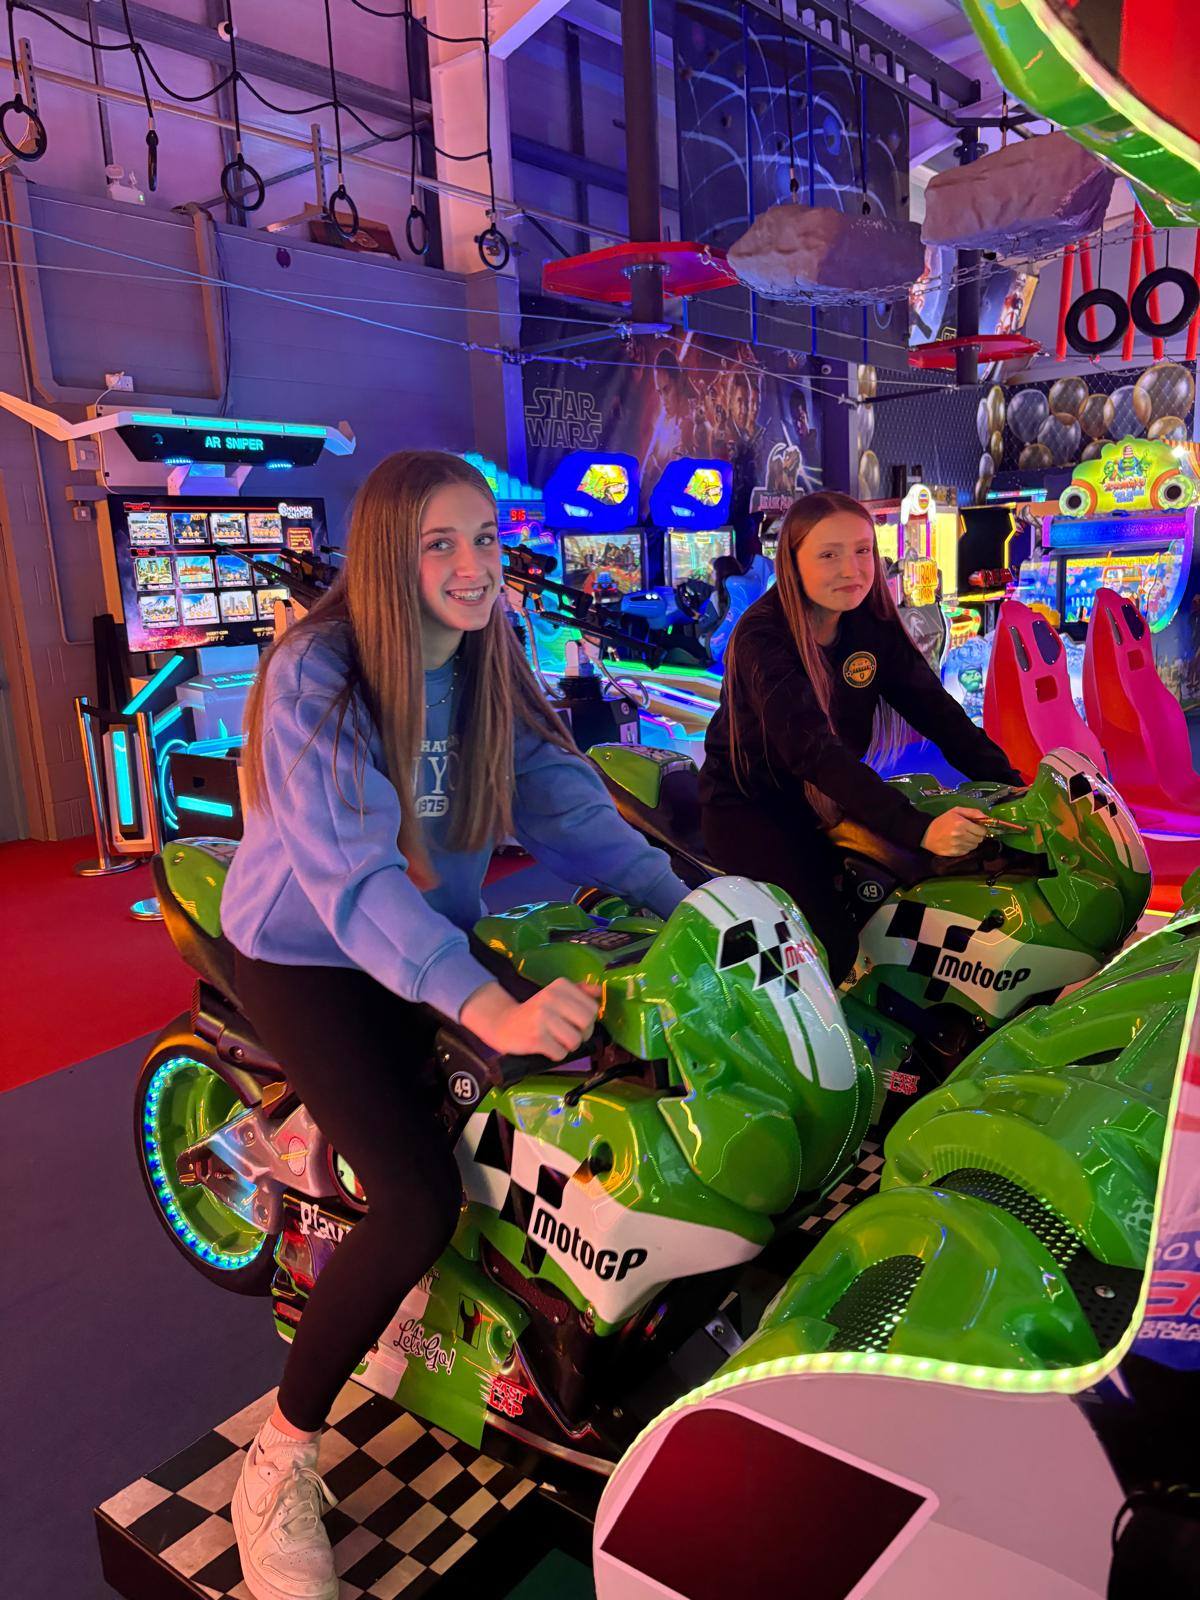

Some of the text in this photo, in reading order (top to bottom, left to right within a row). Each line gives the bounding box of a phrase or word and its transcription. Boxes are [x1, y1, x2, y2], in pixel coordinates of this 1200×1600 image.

[524, 387, 602, 422] STAR
[205, 435, 264, 451] AR SNIPER
[525, 417, 602, 450] WARS
[863, 885, 878, 898] 49
[937, 954, 1031, 992] motoGP
[454, 1078, 472, 1099] 49
[889, 1081, 918, 1096] LAP
[890, 1070, 920, 1084] FAST
[532, 1207, 648, 1282] motoGP
[393, 1318, 457, 1376] Let's Go!
[488, 1390, 524, 1418] LAP
[490, 1378, 527, 1405] FAST
